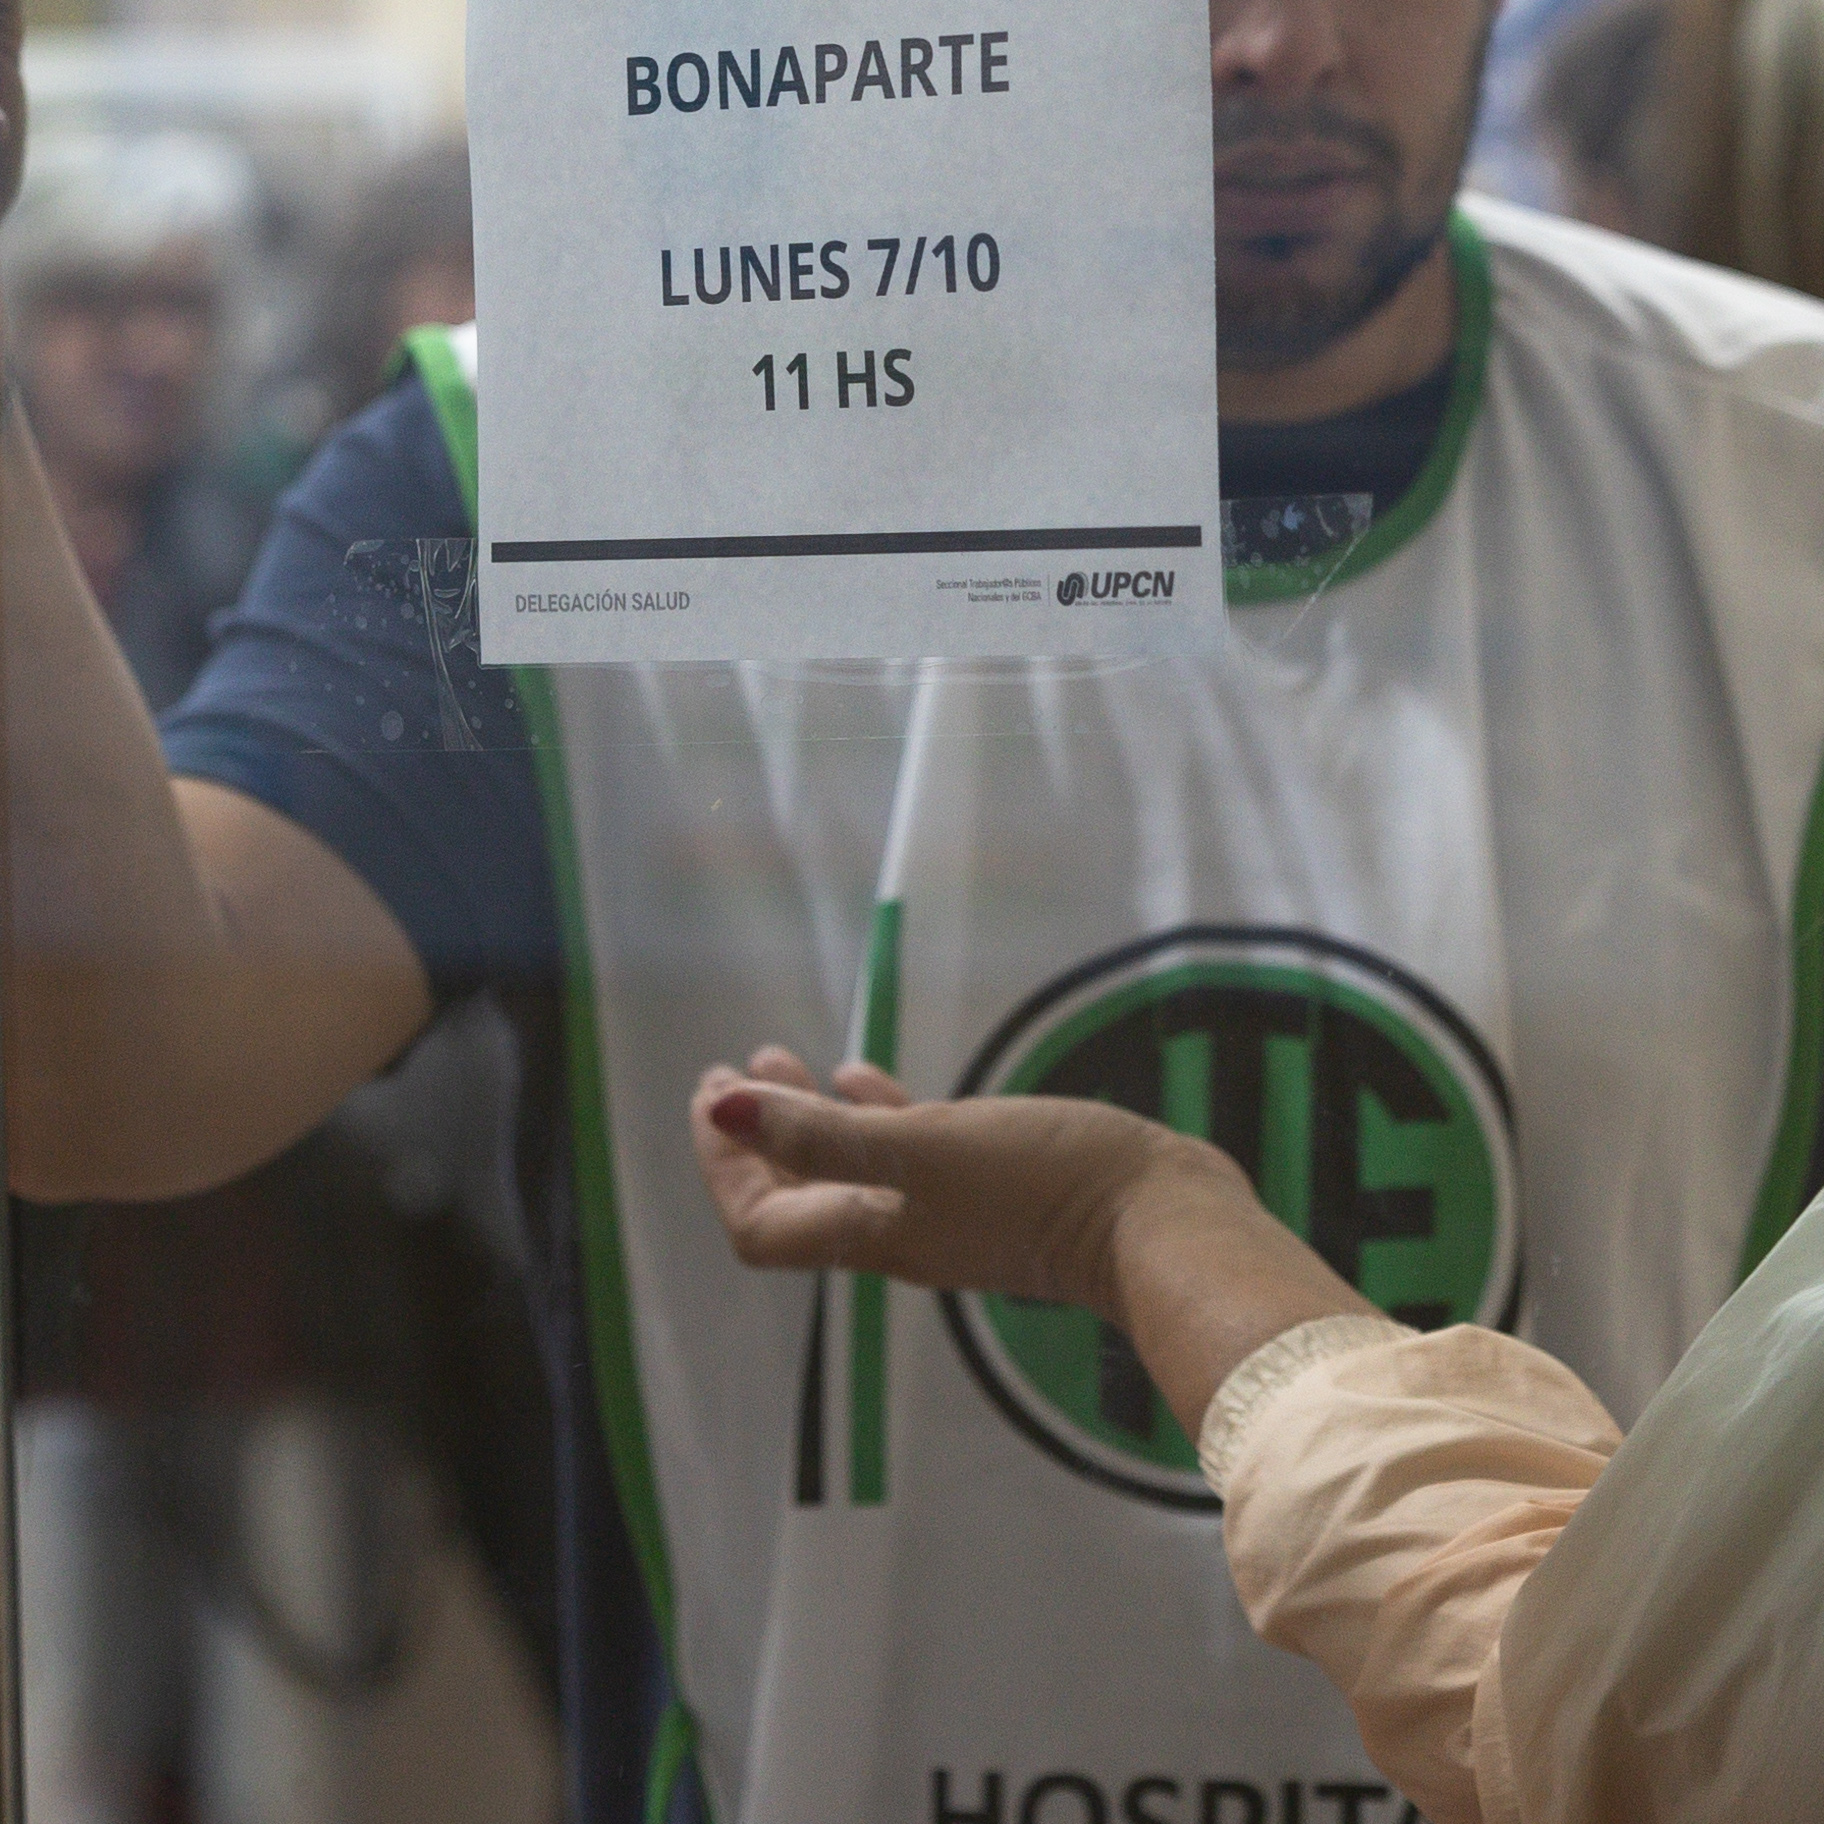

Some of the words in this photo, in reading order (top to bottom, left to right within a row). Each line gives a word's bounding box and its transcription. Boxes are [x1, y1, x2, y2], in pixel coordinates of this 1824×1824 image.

[626, 30, 1011, 117] BONAPARTE
[660, 237, 849, 308] LUNES
[866, 231, 1002, 301] 7/10
[750, 350, 811, 413] 11
[835, 347, 916, 410] HS
[515, 588, 627, 613] DELEGACIÓN
[631, 591, 691, 612] SALUD
[1090, 570, 1175, 599] UPCN
[928, 1770, 1426, 1824] HOSPIT
